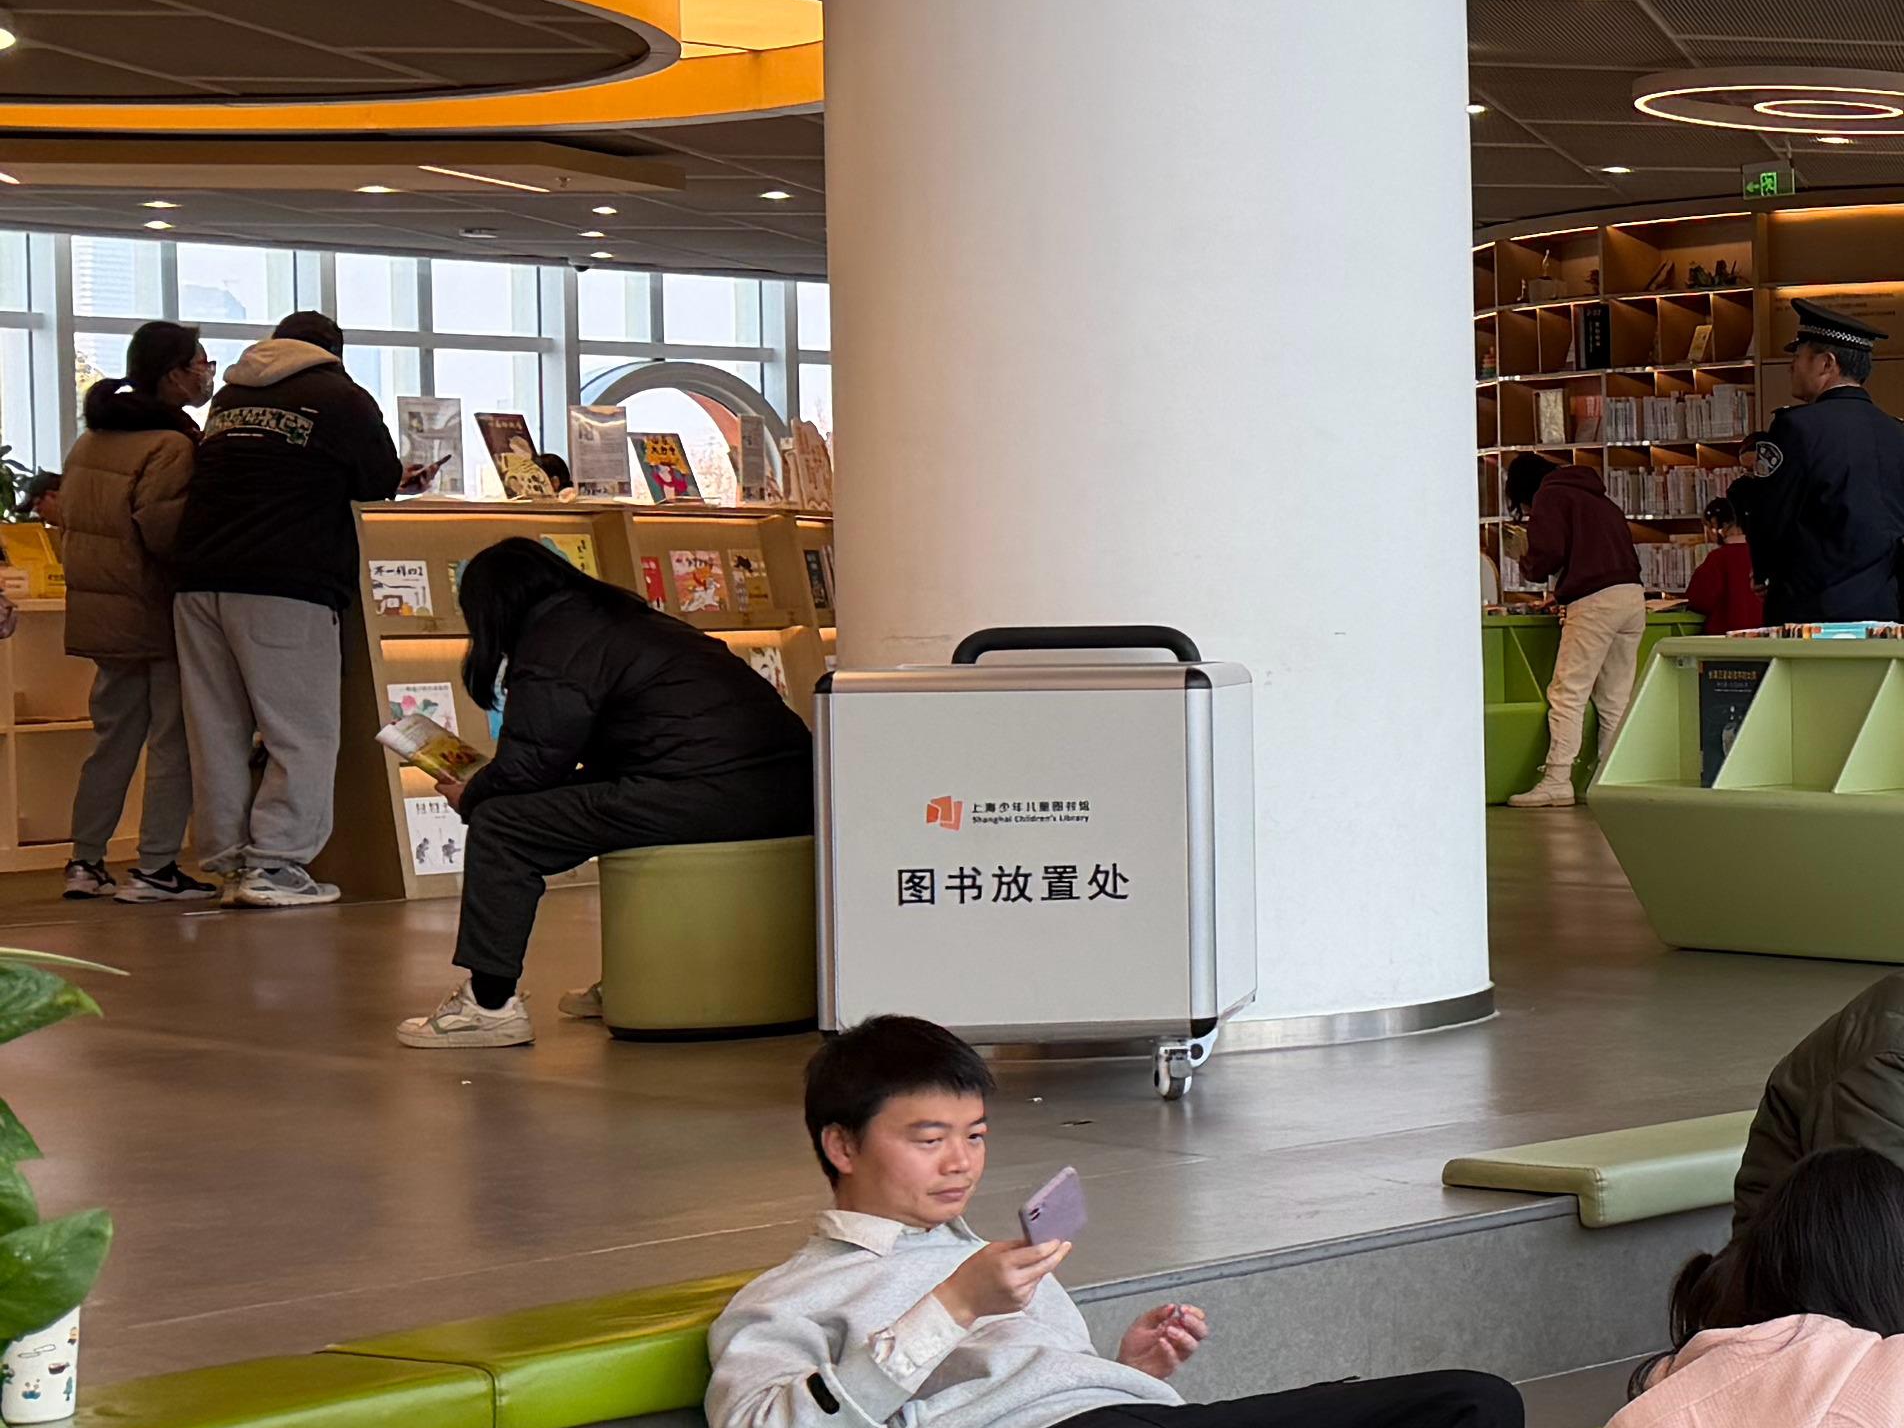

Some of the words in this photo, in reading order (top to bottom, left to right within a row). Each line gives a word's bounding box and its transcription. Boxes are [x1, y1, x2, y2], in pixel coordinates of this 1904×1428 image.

[972, 816, 1012, 824] Shanghai
[1014, 814, 1056, 823] Children's
[1059, 814, 1089, 823] Library
[897, 862, 1130, 906] 图书放置处
